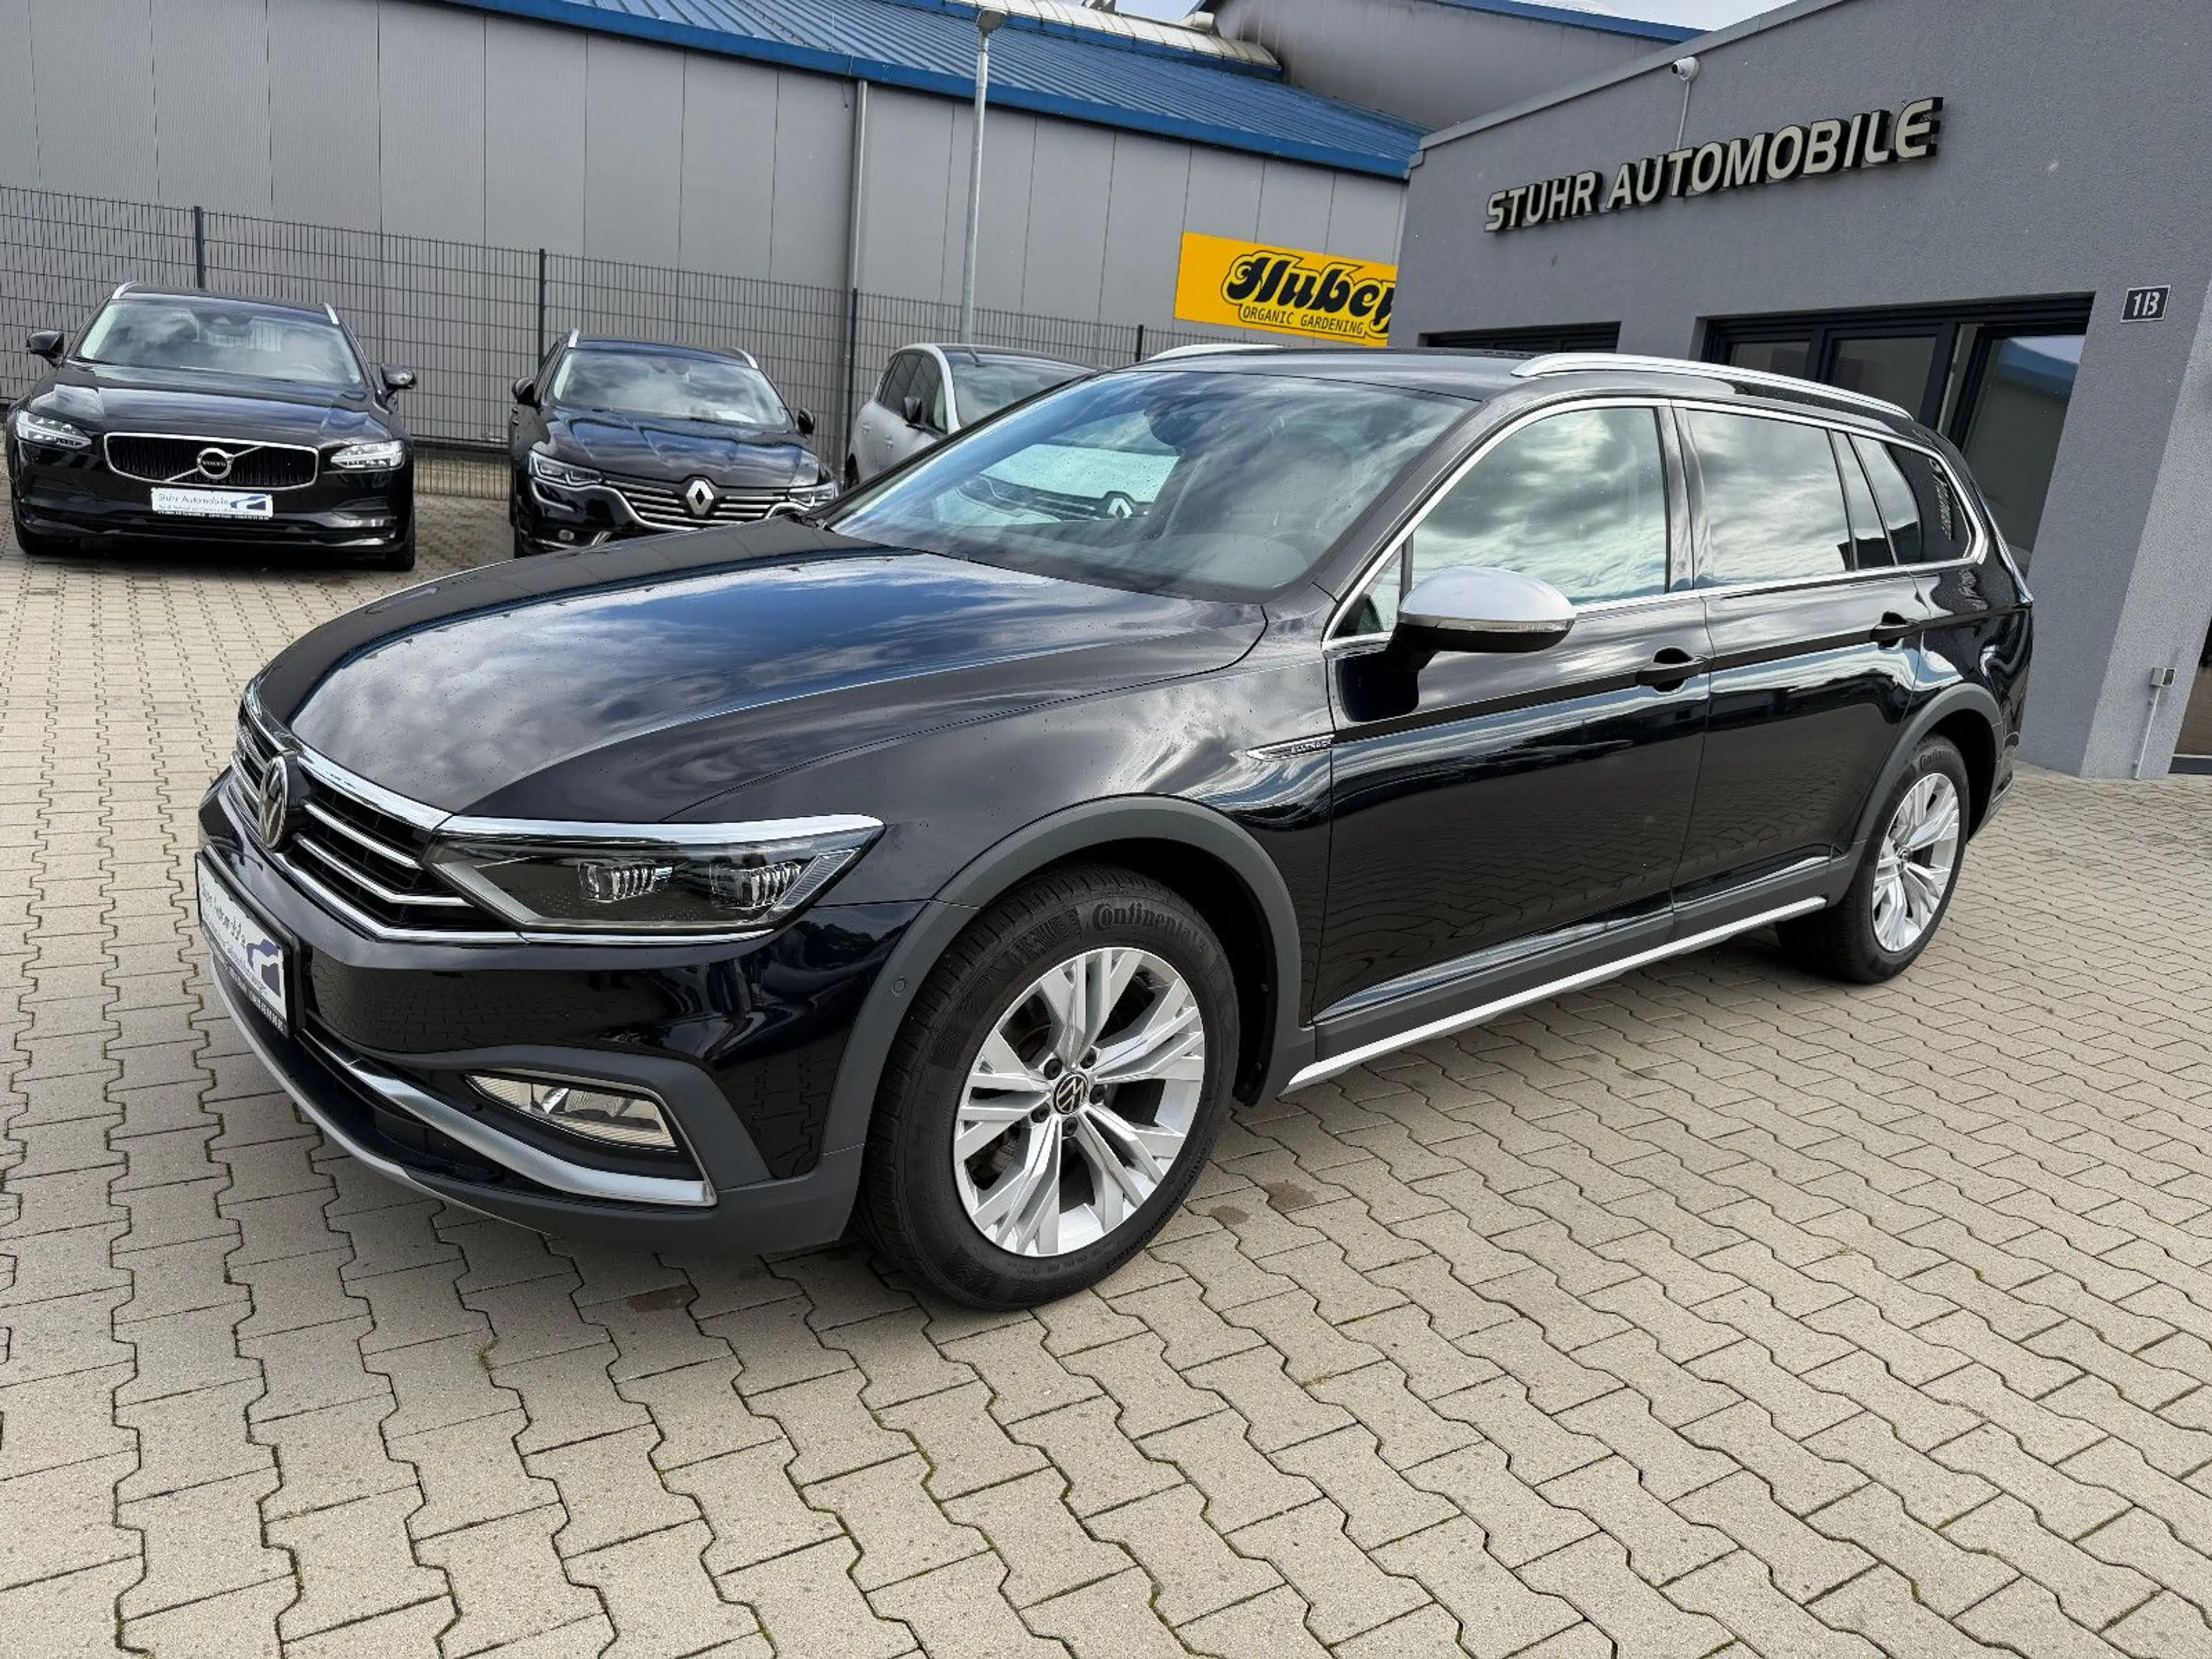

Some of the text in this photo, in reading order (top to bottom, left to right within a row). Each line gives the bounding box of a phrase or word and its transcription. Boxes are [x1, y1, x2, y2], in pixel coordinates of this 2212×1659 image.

[1484, 97, 1939, 232] STUHR AUTOMOBILE
[2133, 291, 2160, 316] 1B
[1243, 305, 1365, 335] ORGANIC GARDENING
